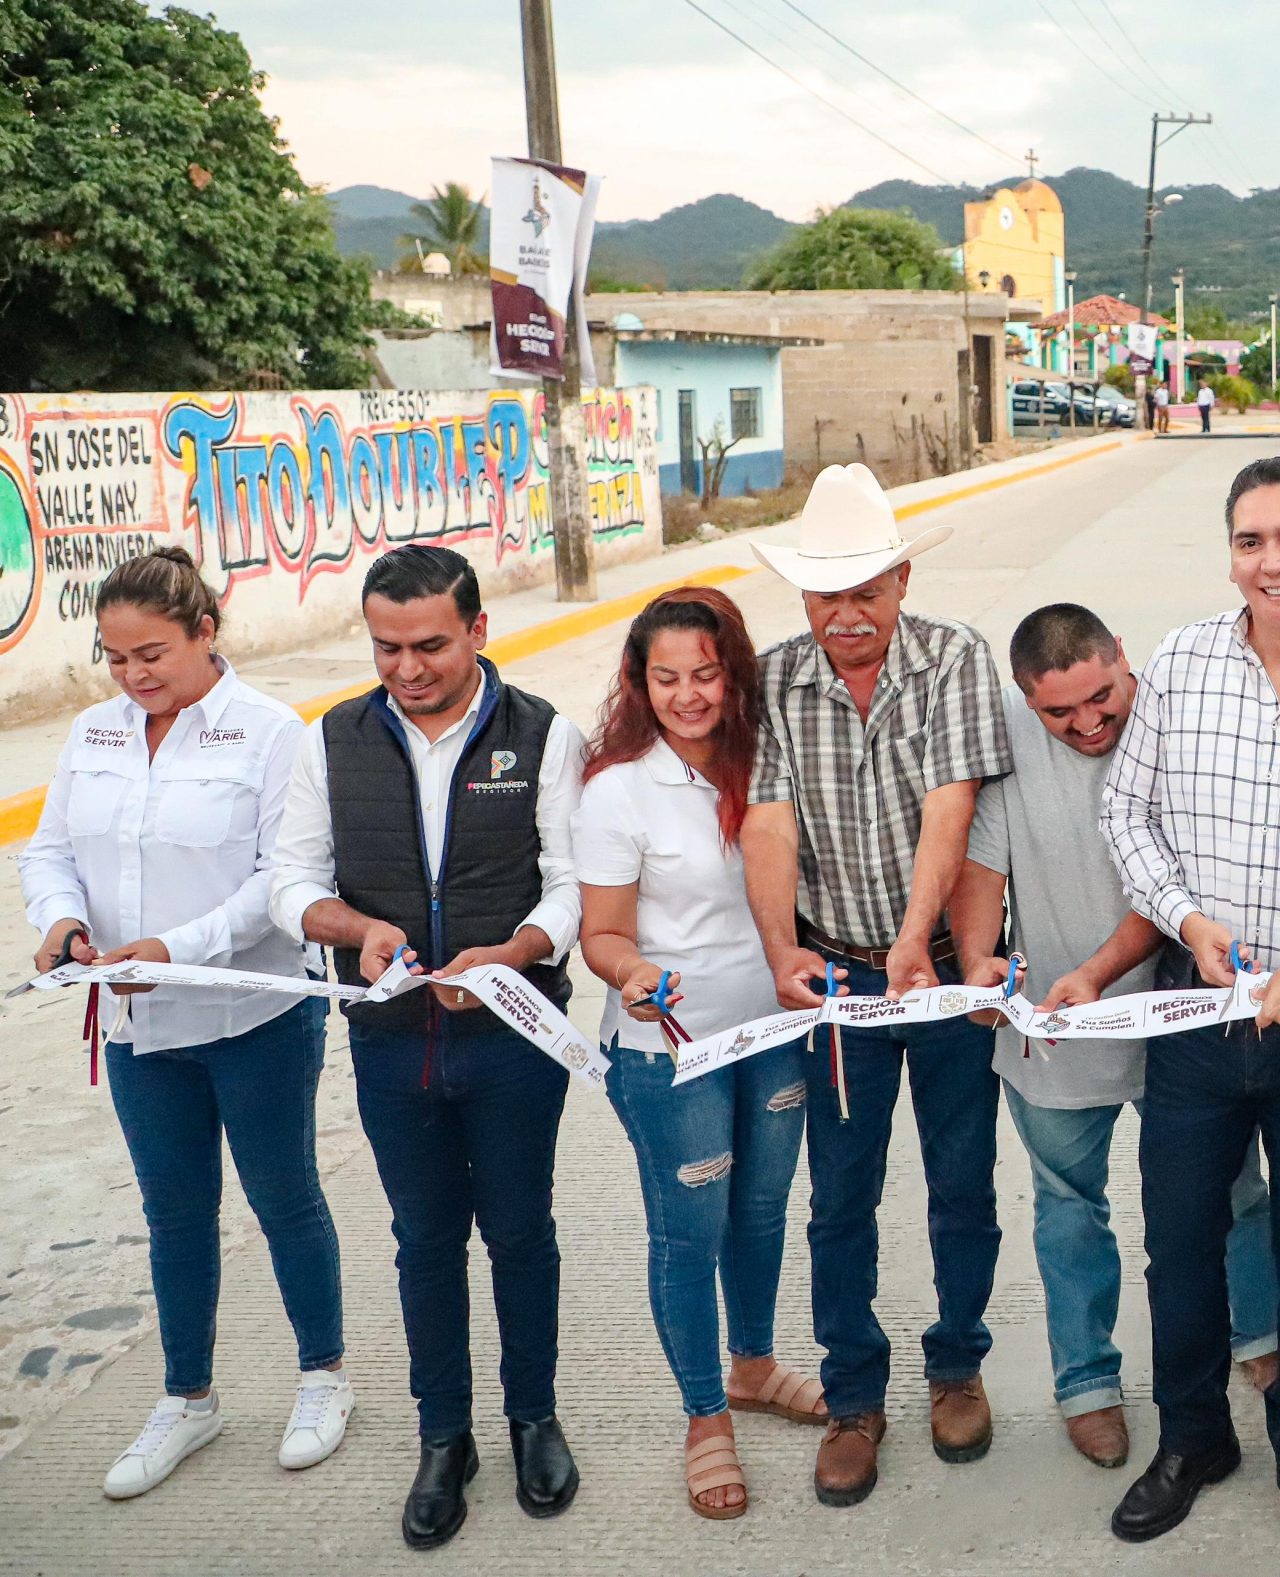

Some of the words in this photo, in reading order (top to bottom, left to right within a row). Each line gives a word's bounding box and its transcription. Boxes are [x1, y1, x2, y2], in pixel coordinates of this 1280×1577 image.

[30, 431, 59, 476] SN
[67, 427, 112, 471] JOSE
[118, 425, 152, 468] DEL
[37, 483, 94, 529] VALLE
[100, 480, 141, 526] NAY.
[45, 533, 94, 574] ARENA
[84, 736, 126, 748] SERVIR
[86, 727, 124, 738] HECHO
[490, 976, 540, 1023] HECHOS
[494, 992, 538, 1035] SERVIR
[514, 985, 543, 1014] ESTAMOS
[849, 1007, 906, 1021] SERVIR
[1163, 1002, 1217, 1023] SERVIR
